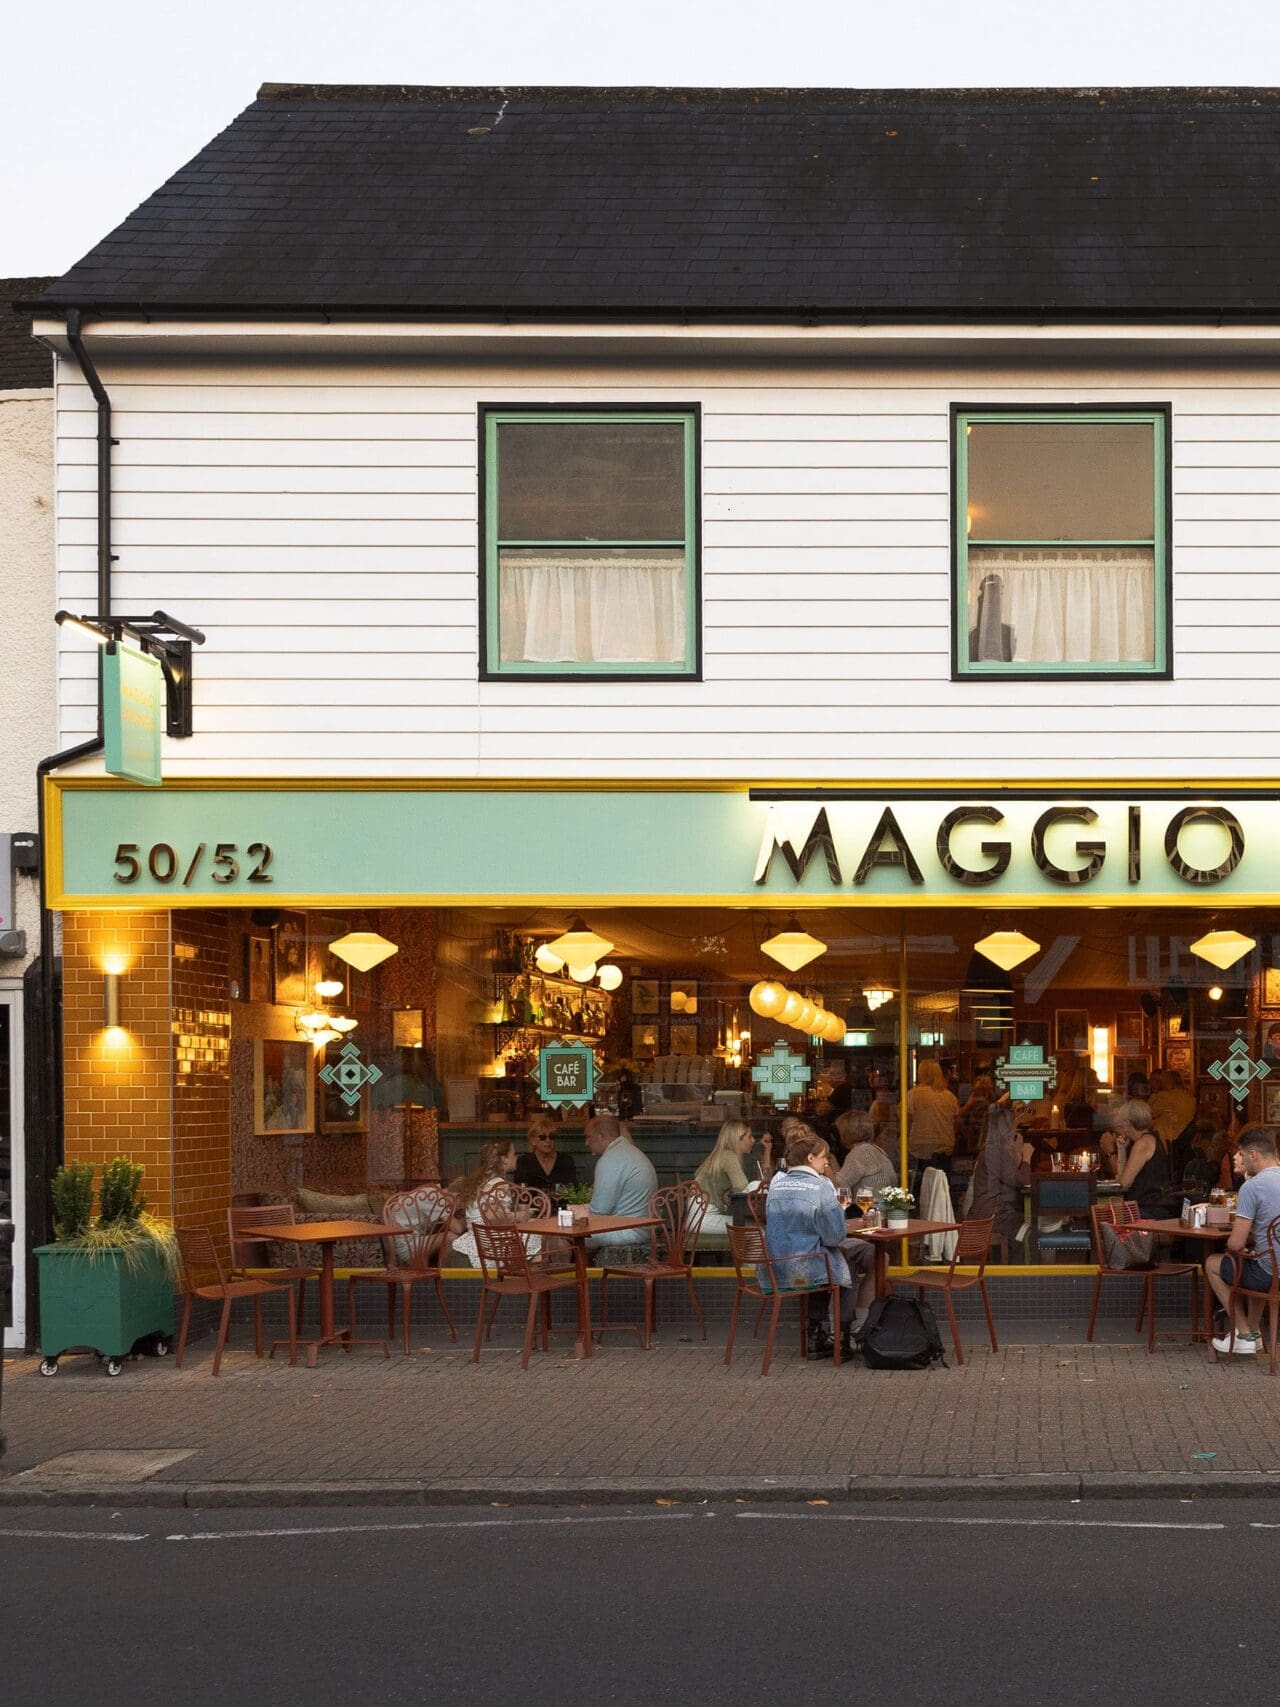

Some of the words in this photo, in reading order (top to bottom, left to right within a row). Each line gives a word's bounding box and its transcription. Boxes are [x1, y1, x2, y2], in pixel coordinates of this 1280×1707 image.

[753, 805, 1246, 885] MAGGIO
[113, 842, 274, 887] 50/52
[554, 1061, 580, 1075] CAFÉ
[557, 1076, 576, 1087] BAR
[1017, 1085, 1037, 1096] BAR
